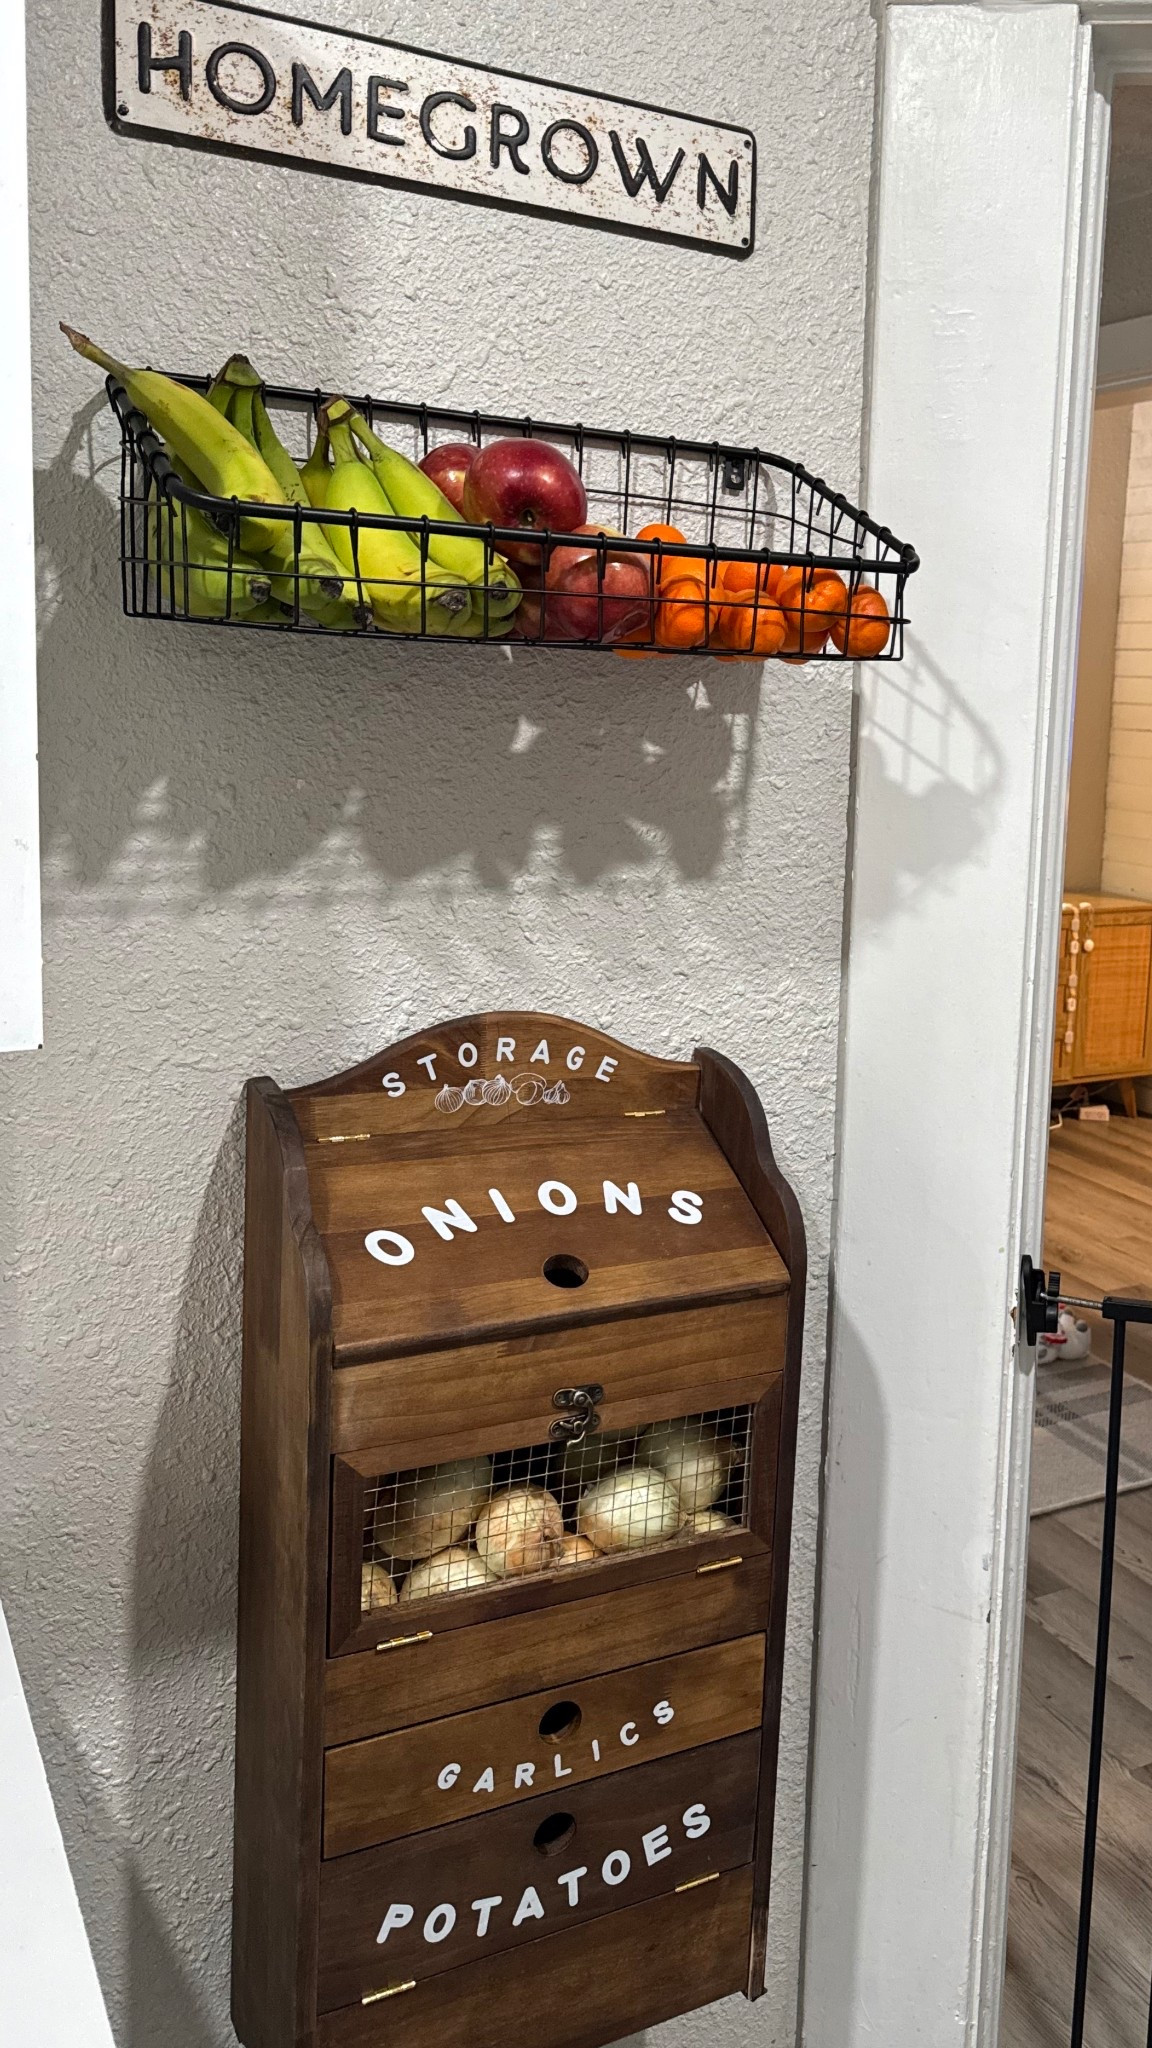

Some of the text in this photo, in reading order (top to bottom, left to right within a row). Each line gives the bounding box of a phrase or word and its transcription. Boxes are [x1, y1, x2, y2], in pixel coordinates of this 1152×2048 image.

[138, 21, 739, 216] HOMEGROWN
[382, 1037, 619, 1098] STORAGE
[364, 1180, 703, 1266] ONIONS
[438, 1700, 675, 1793] GARLICS
[376, 1803, 711, 1944] POTATOES
